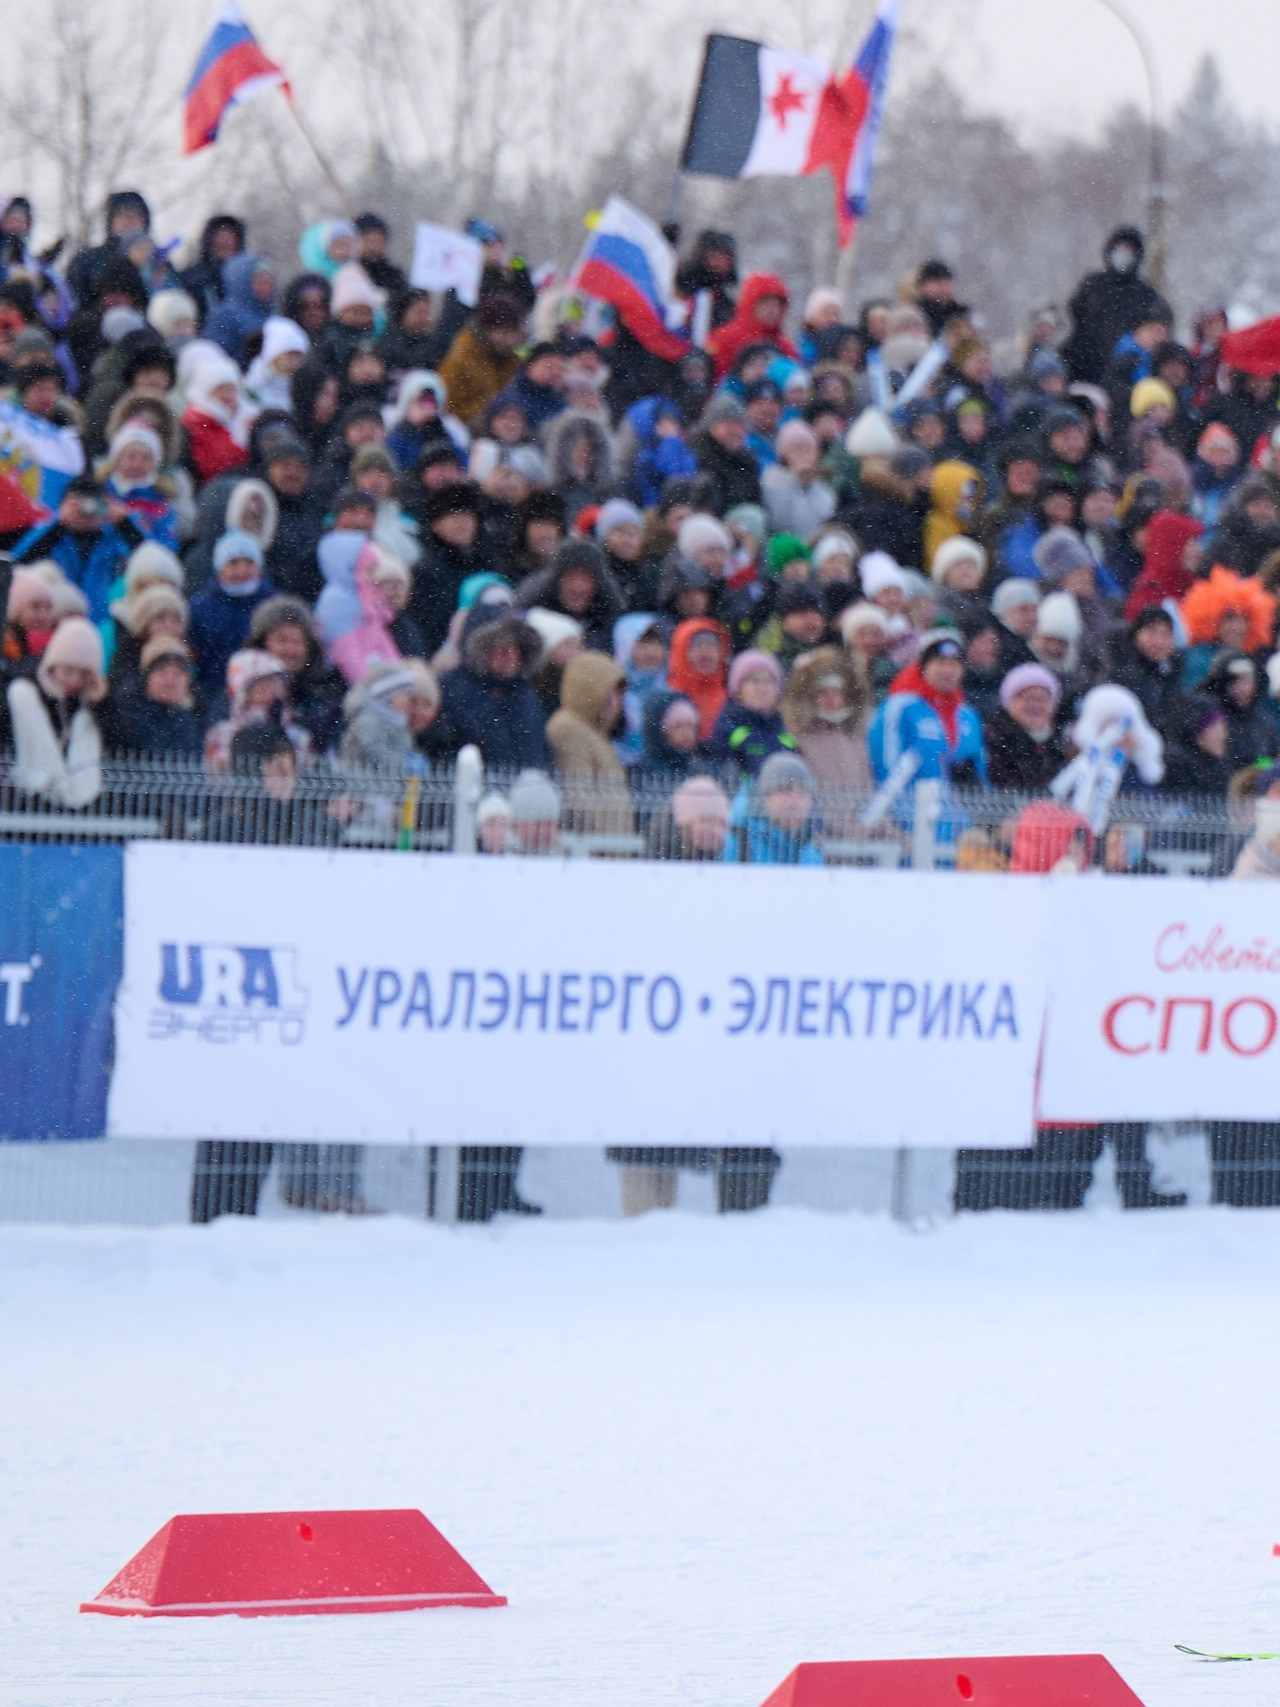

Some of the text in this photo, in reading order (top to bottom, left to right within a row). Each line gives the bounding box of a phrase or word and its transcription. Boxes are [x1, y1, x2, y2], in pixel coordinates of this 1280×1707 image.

[147, 1007, 305, 1046] ЭНЕРГО
[334, 966, 683, 1032] УРАЛЭНЕРГО
[725, 976, 1020, 1040] ЭЛЕКТРИКА
